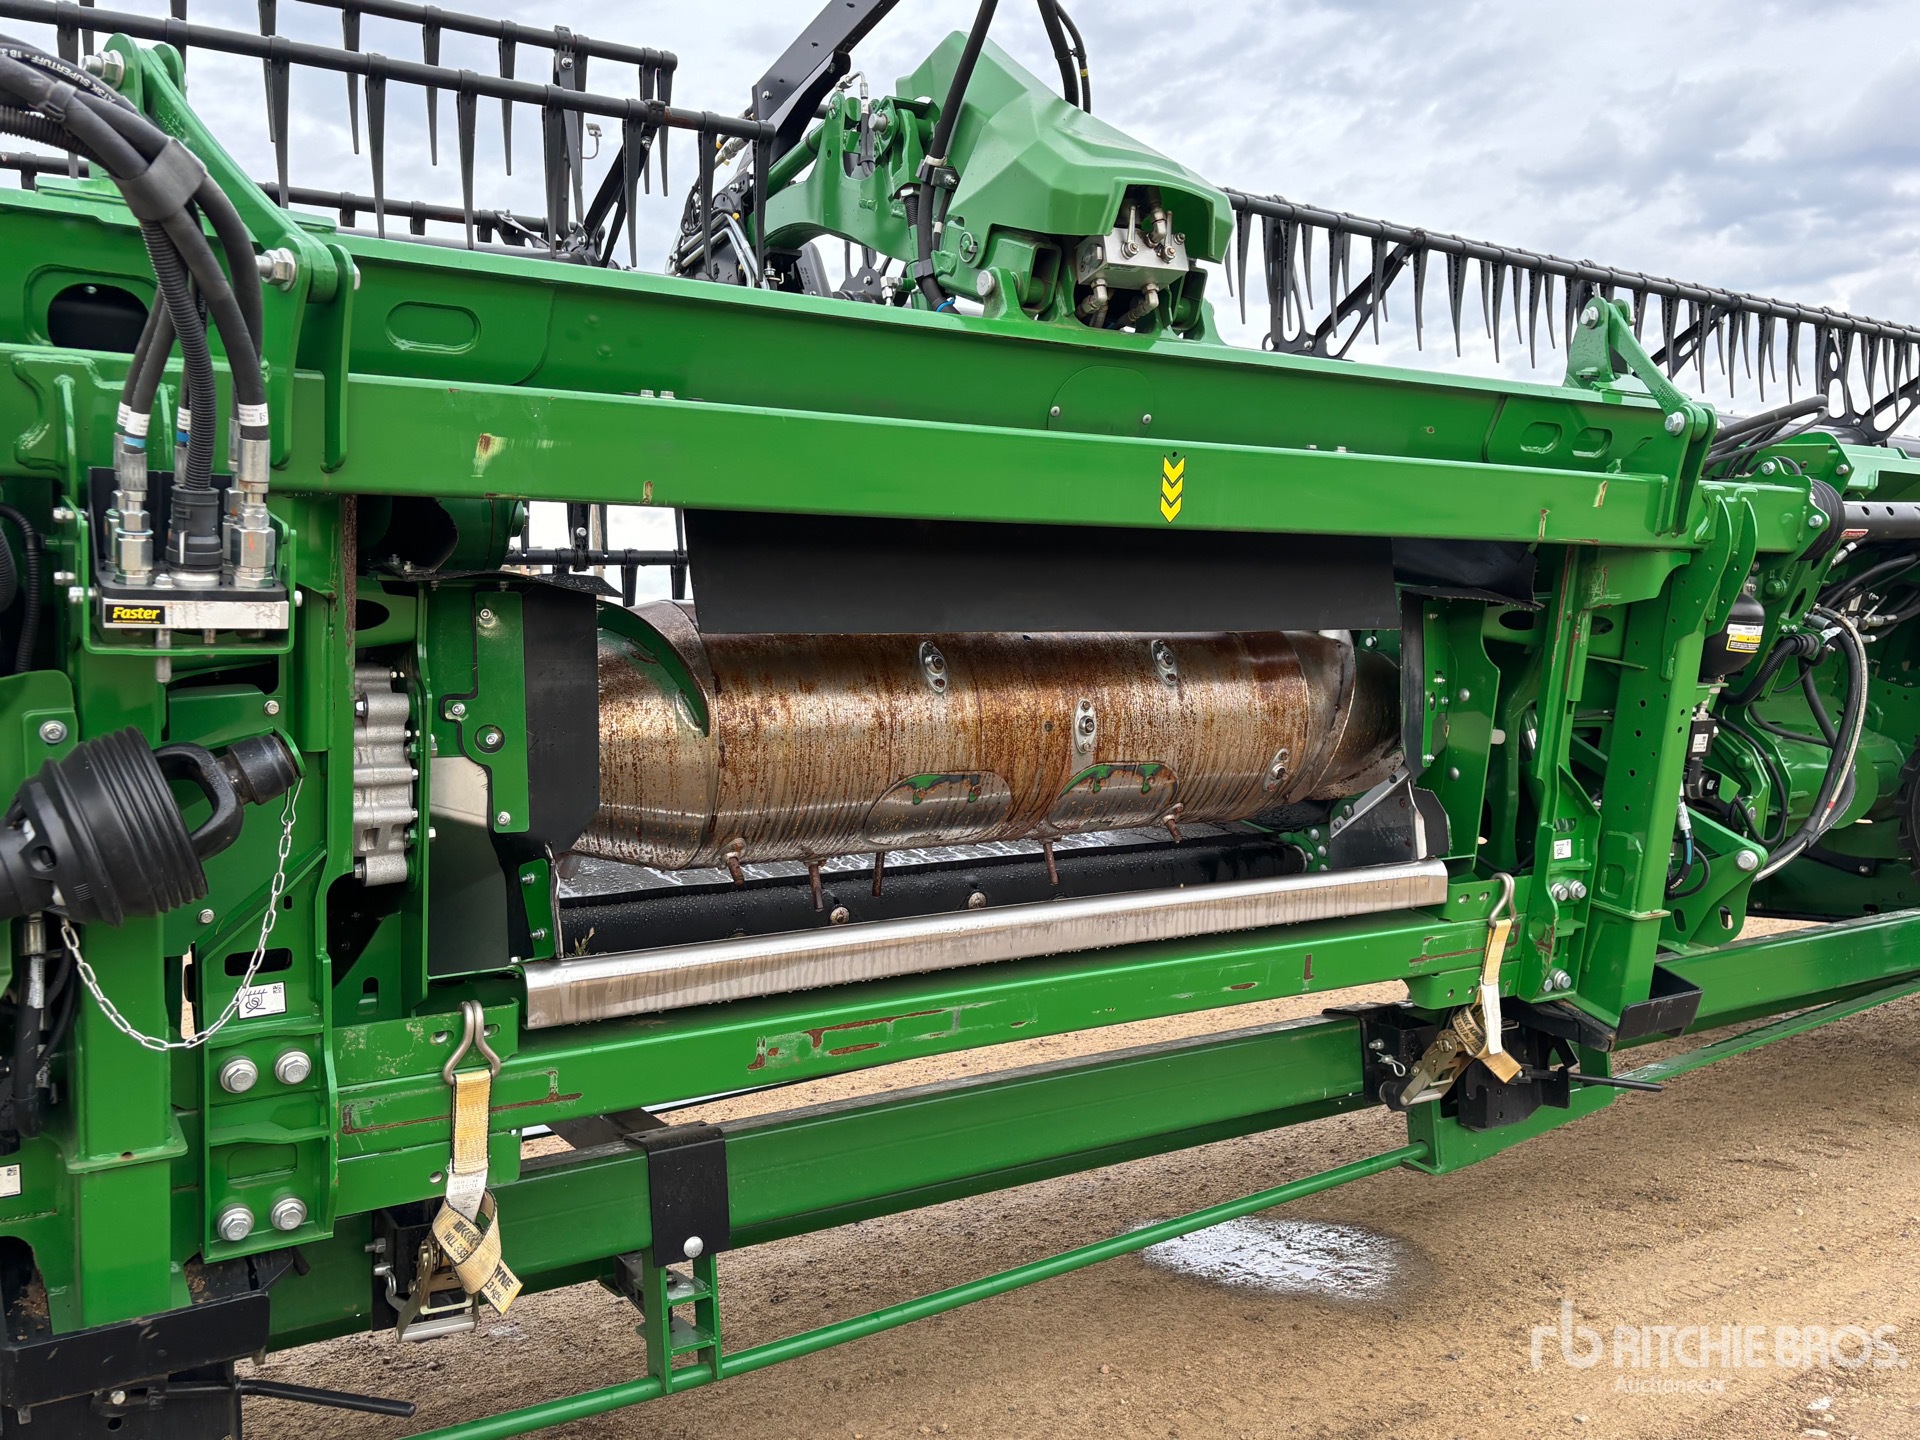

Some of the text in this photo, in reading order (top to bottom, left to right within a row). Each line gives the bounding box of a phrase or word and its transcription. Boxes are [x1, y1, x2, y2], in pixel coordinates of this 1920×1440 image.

[30, 55, 92, 87] SUPERTUFF
[112, 606, 161, 620] Faster
[443, 1230, 469, 1259] WLL 333
